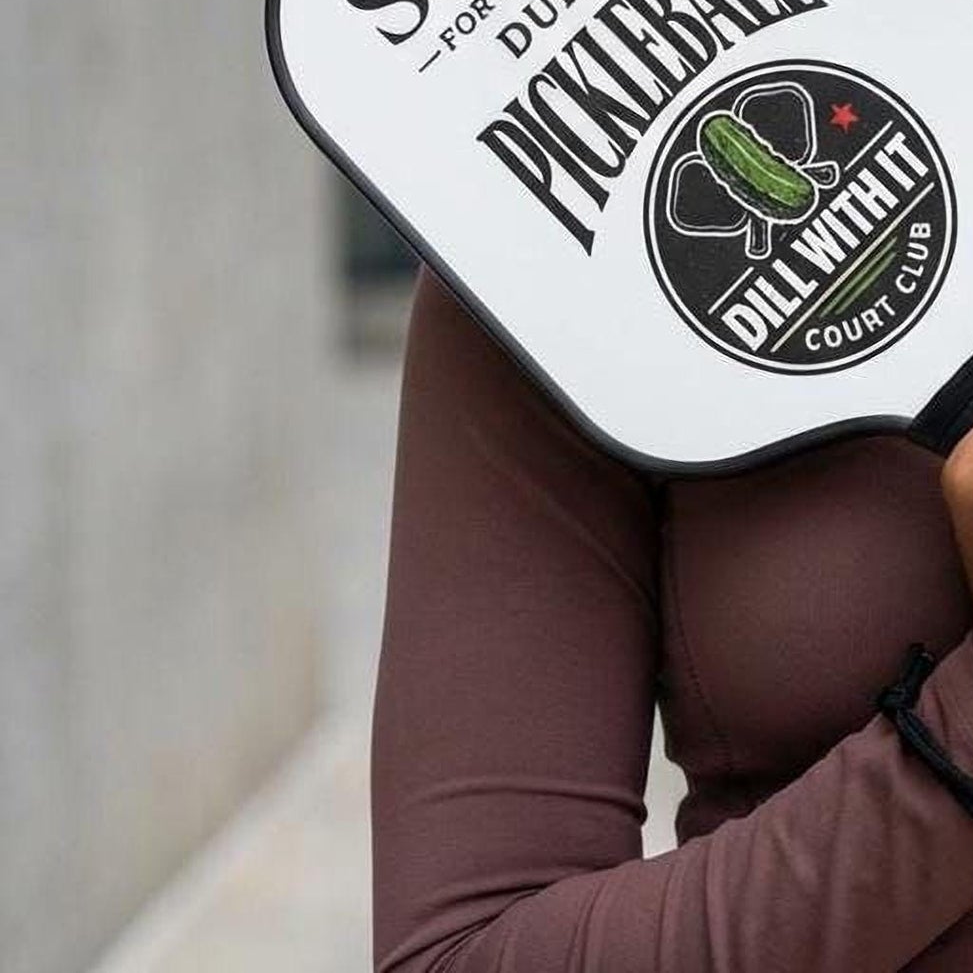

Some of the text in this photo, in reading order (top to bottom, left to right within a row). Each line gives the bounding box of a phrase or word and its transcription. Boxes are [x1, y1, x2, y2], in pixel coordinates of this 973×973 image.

[721, 131, 929, 352] DILL WITH IT
[805, 222, 931, 351] COURT CLUB
